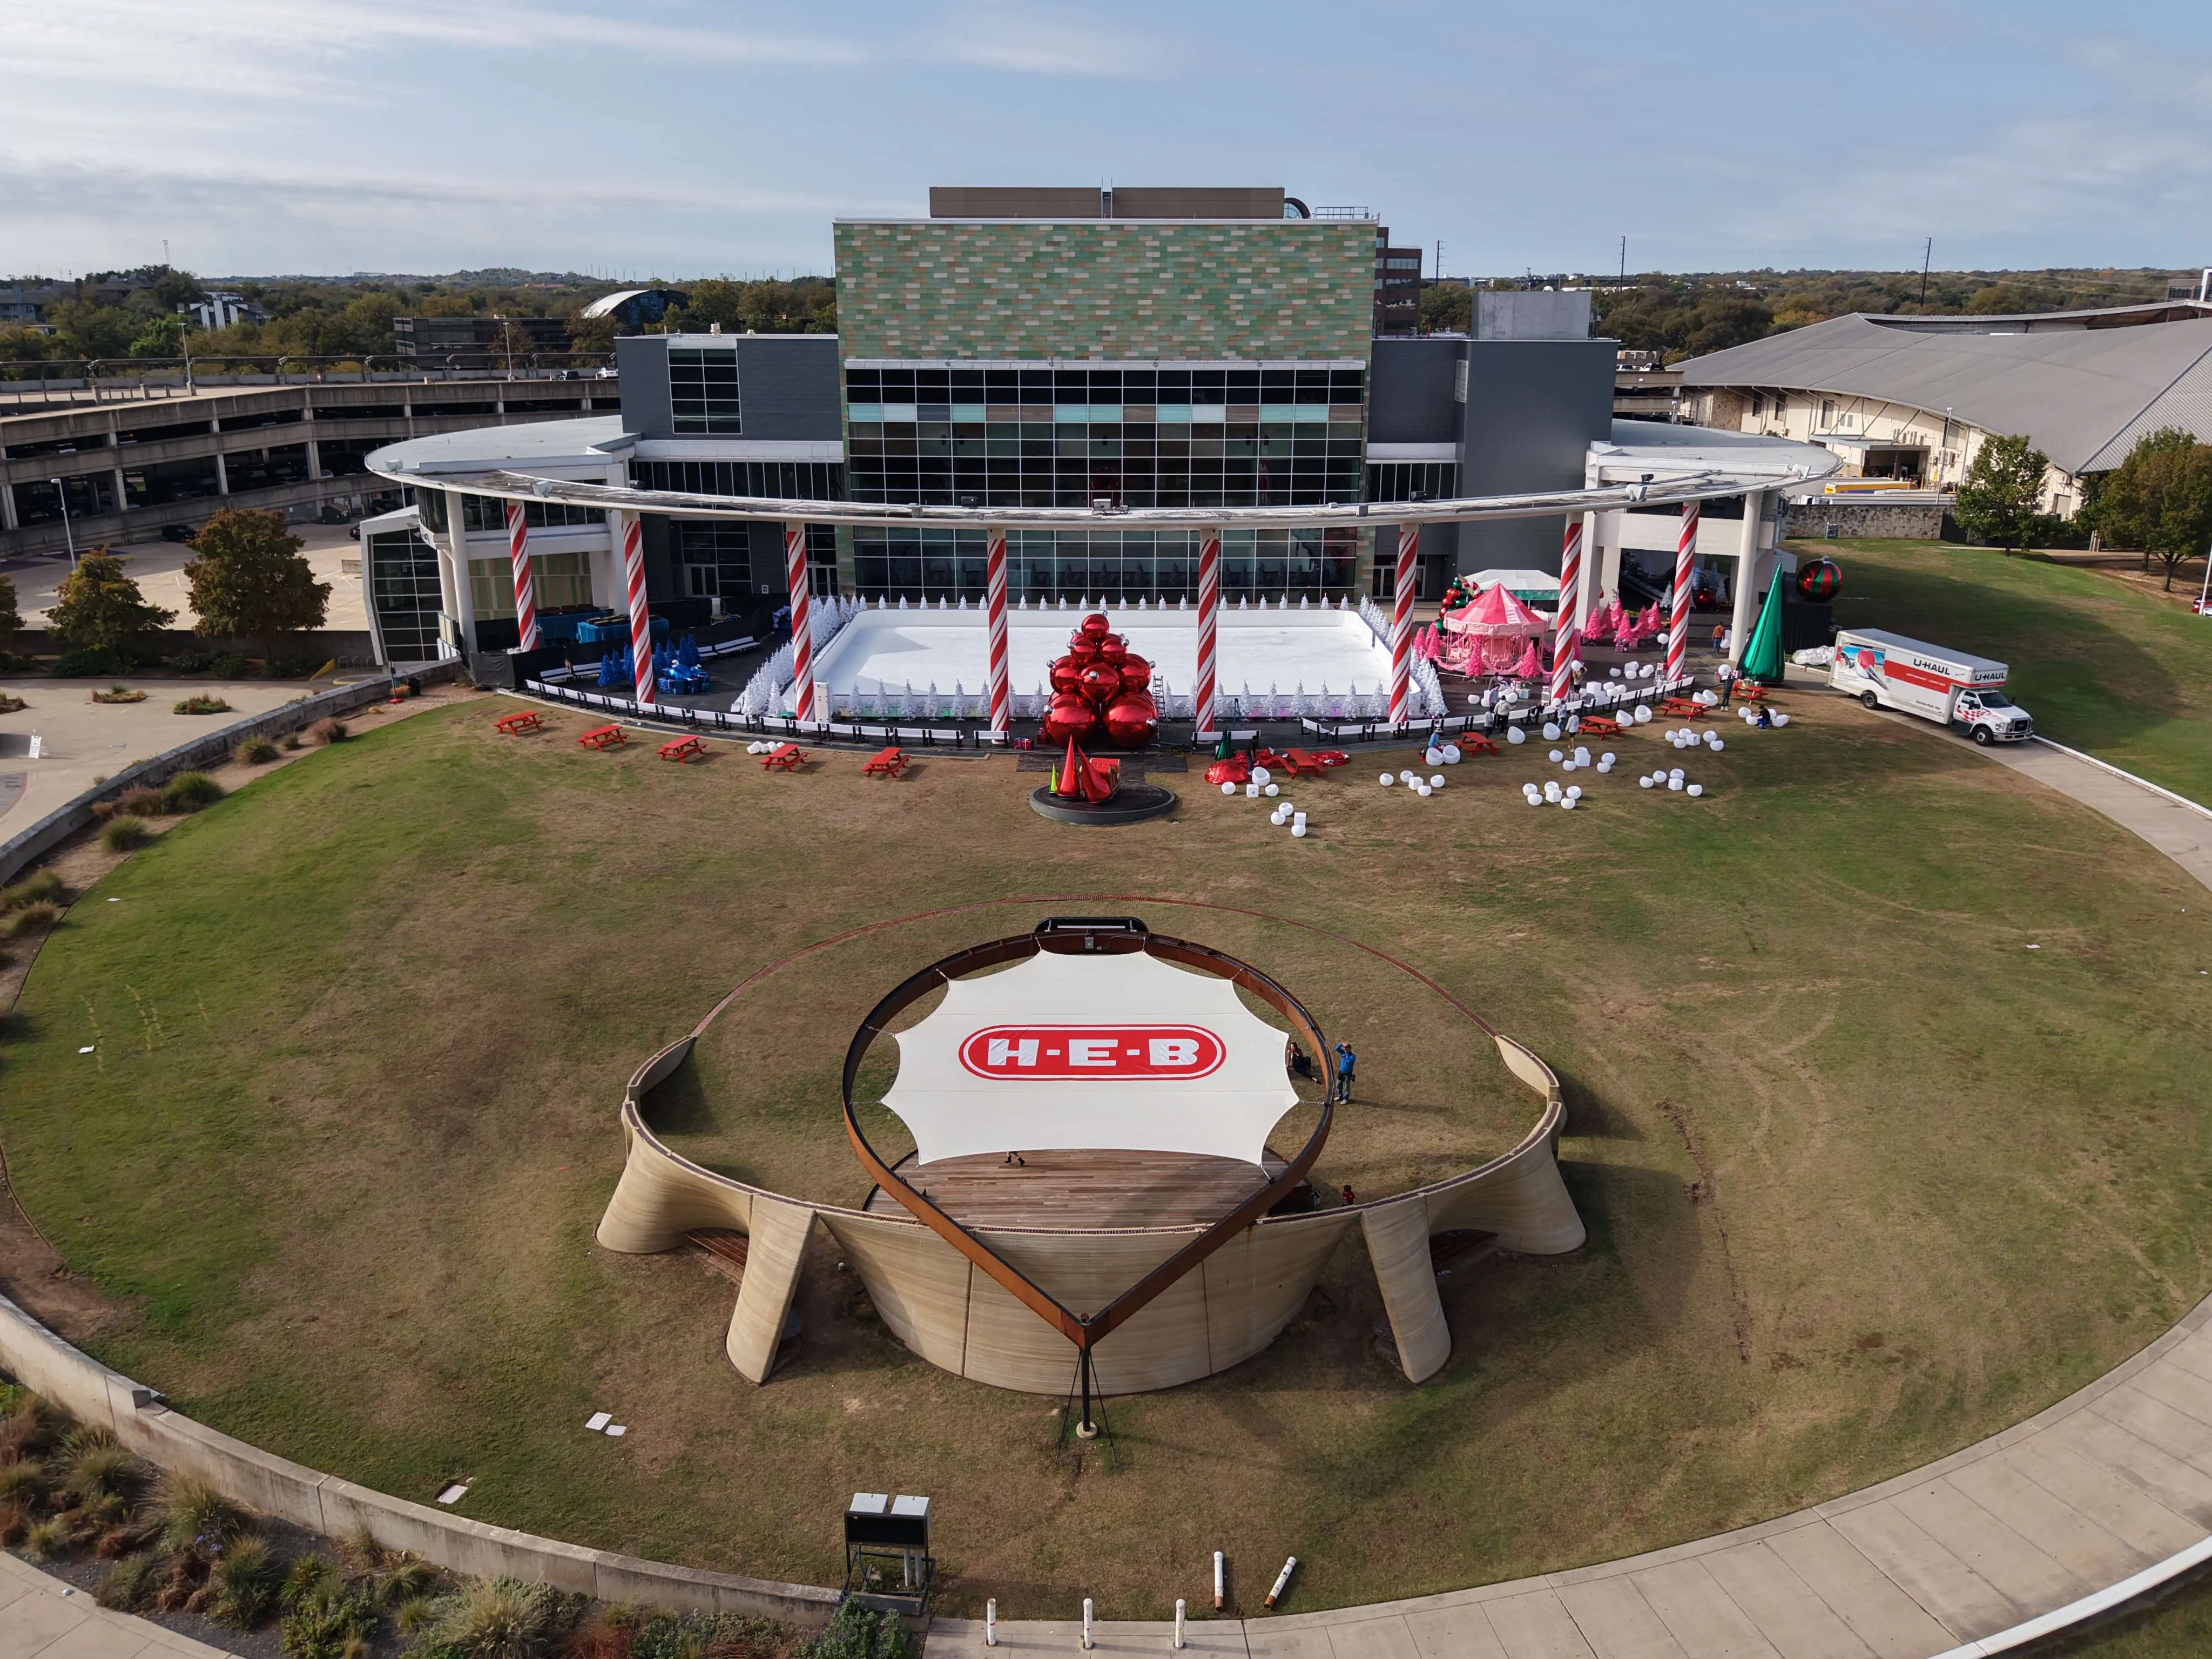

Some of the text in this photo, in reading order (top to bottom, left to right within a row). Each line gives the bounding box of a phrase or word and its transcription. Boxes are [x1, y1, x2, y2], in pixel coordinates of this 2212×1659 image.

[1913, 658, 1950, 675] U-HAUL
[1975, 672, 2005, 681] U-HAUL
[987, 1038, 1199, 1067] H-E-B
